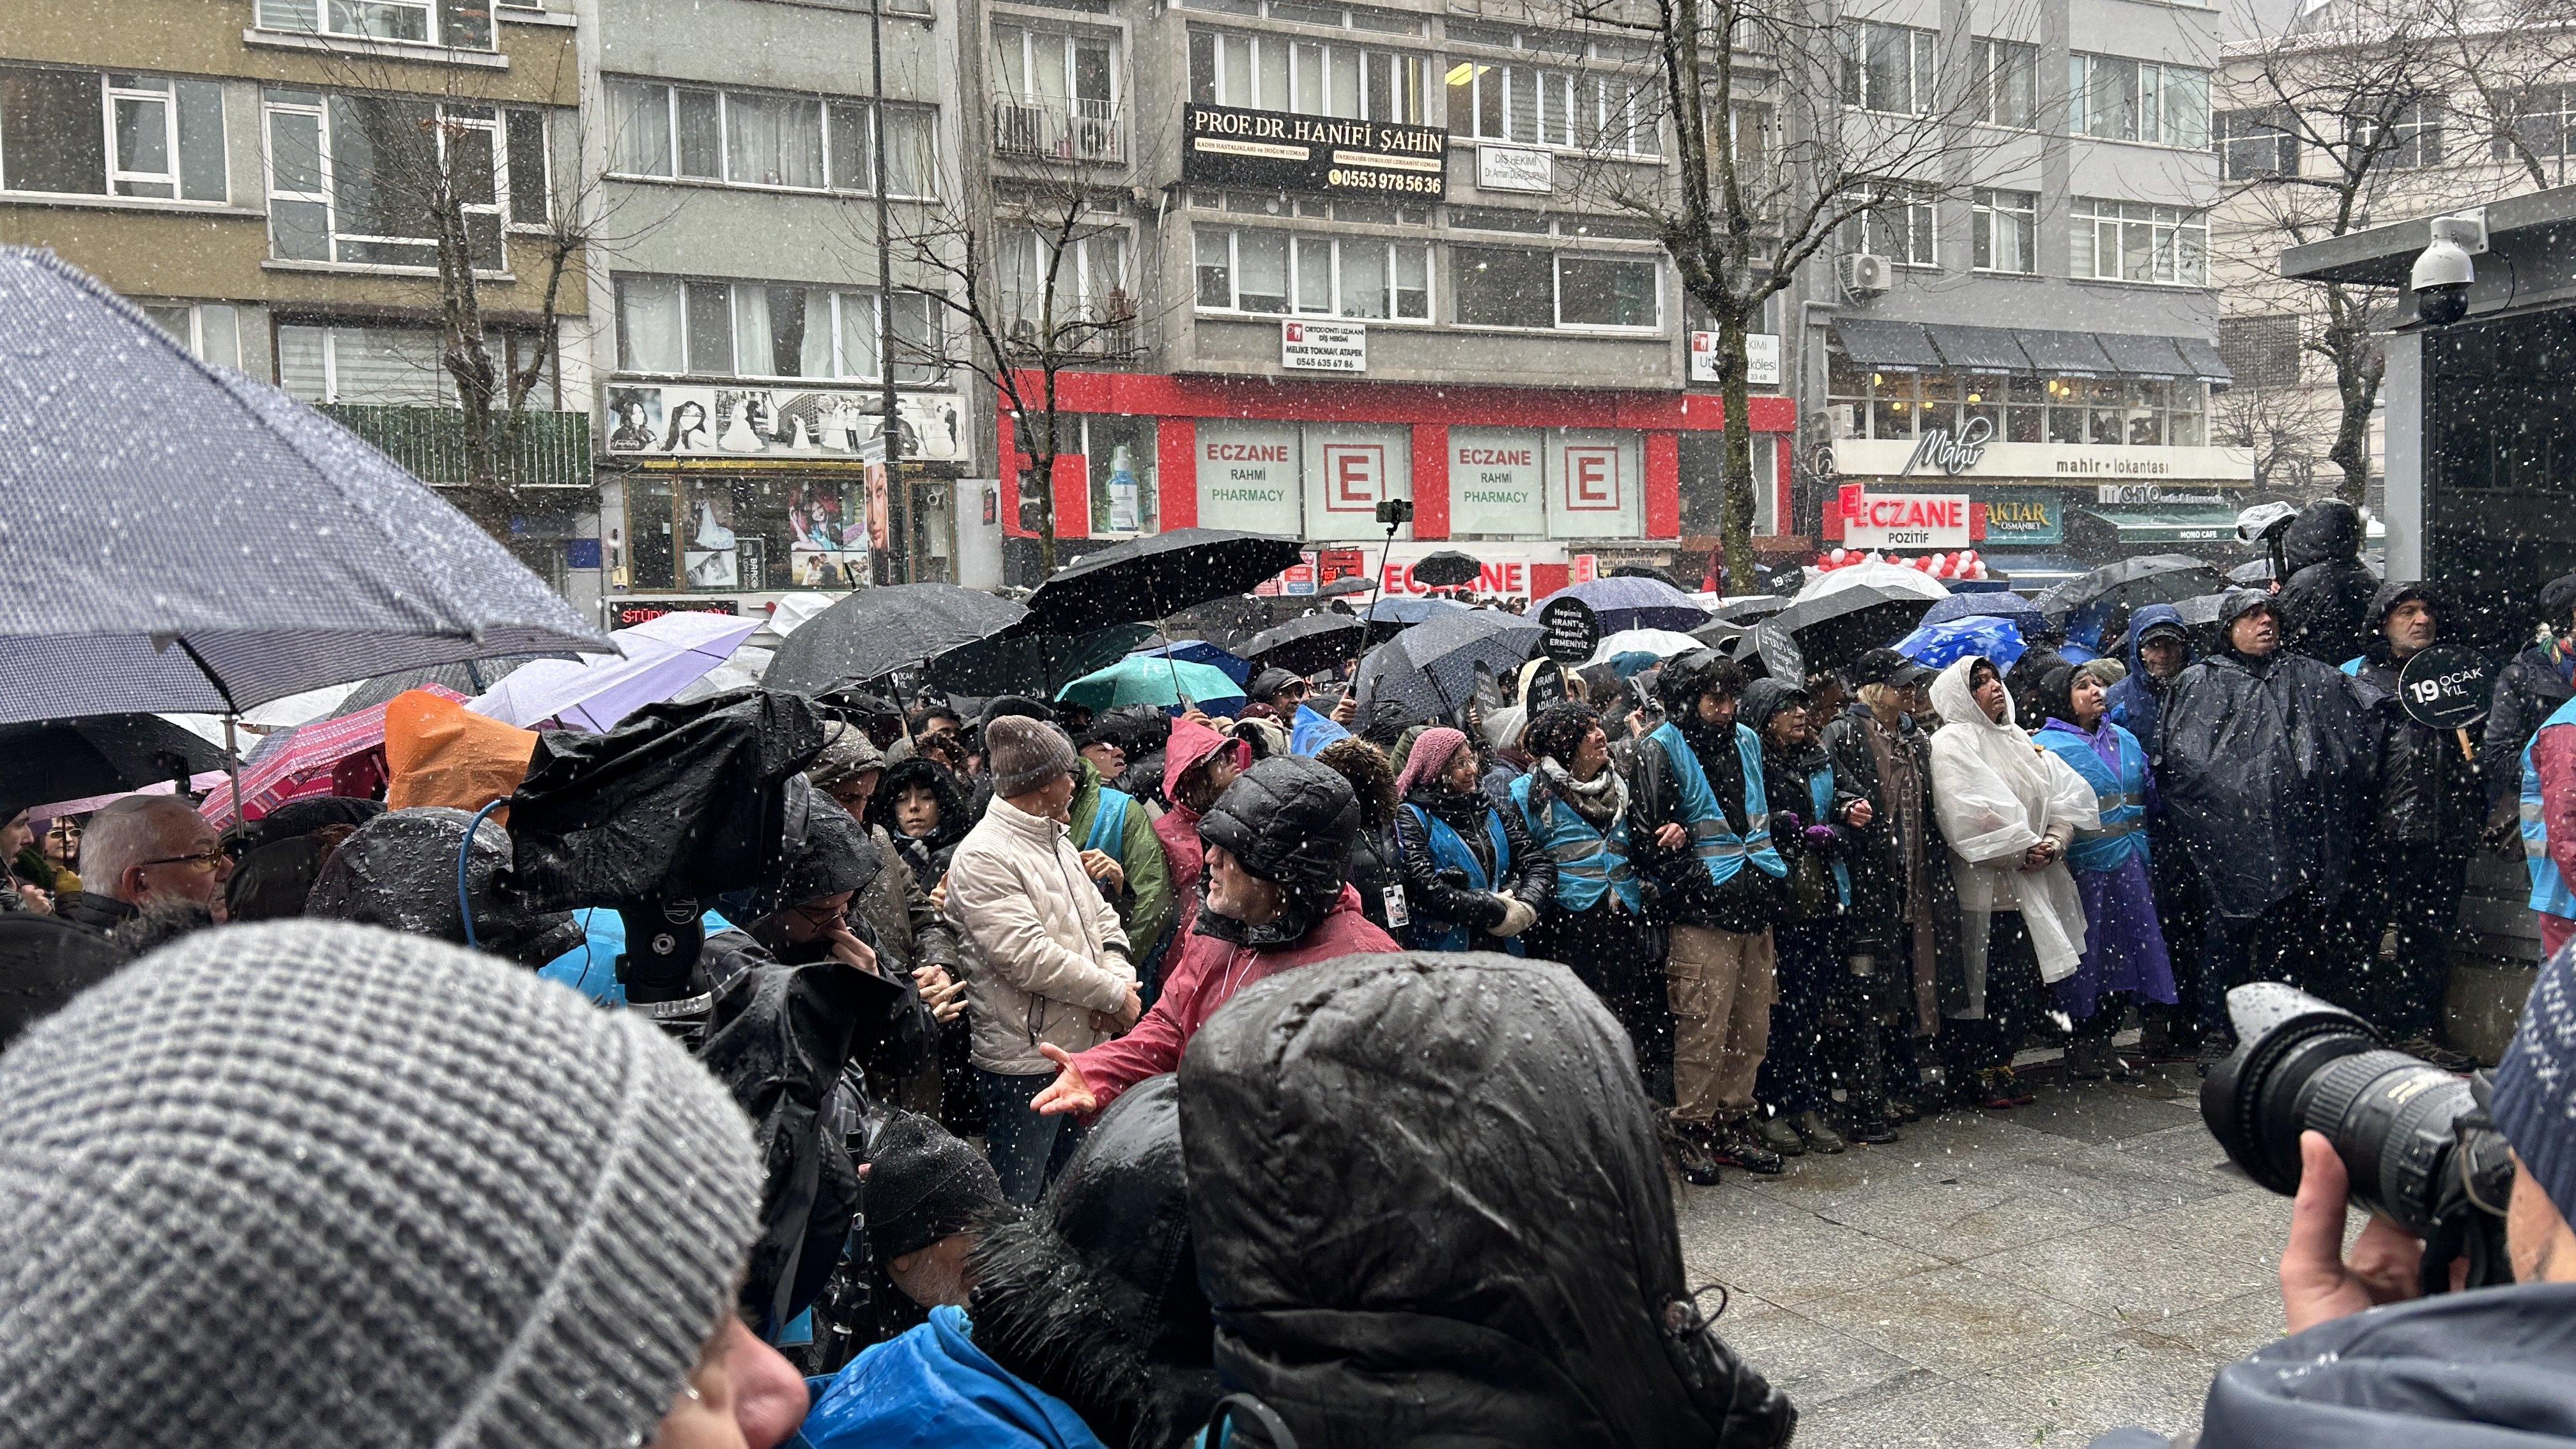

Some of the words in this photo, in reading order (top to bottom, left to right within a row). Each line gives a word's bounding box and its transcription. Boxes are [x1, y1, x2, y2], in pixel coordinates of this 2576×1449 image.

[1381, 129, 1442, 153] ŞAHİN
[1216, 142, 1256, 153] HASTALIKLARI
[1285, 150, 1307, 158] UZMANI
[1286, 344, 1308, 355] MELİKE
[1340, 348, 1363, 357] ATAPEK
[1297, 358, 1315, 366] 0545
[1317, 359, 1331, 367] 635
[1333, 360, 1342, 368] 67
[1207, 443, 1288, 461] ECZANE
[1903, 416, 1992, 477] Mahir
[1459, 448, 1531, 466] ECZANE
[2057, 457, 2101, 473] mahir
[2114, 458, 2169, 474] lokantası
[1231, 467, 1266, 480] RAHMİ
[1481, 470, 1512, 484] RAHMİ
[1212, 489, 1284, 502] PHARMACY
[1464, 491, 1528, 503] PHARMACY
[1986, 501, 2051, 526] AKTAR
[2001, 521, 2041, 532] OSMANBEY
[1889, 530, 1929, 544] POZİTİF
[2202, 530, 2218, 539] CAFE
[1771, 576, 1784, 588] 19
[1782, 569, 1800, 578] OCAK
[1554, 608, 1582, 618] Hepimiz
[1555, 627, 1583, 638] Hepimiz
[1549, 638, 1588, 649] ERMENİYİZ
[898, 672, 914, 680] OCAK
[1535, 672, 1556, 687] HRANT
[899, 680, 907, 689] YIL
[2409, 679, 2439, 703] 19
[2439, 667, 2484, 686] OCAK
[2442, 684, 2467, 697] YIL
[1541, 686, 1552, 699] İçin
